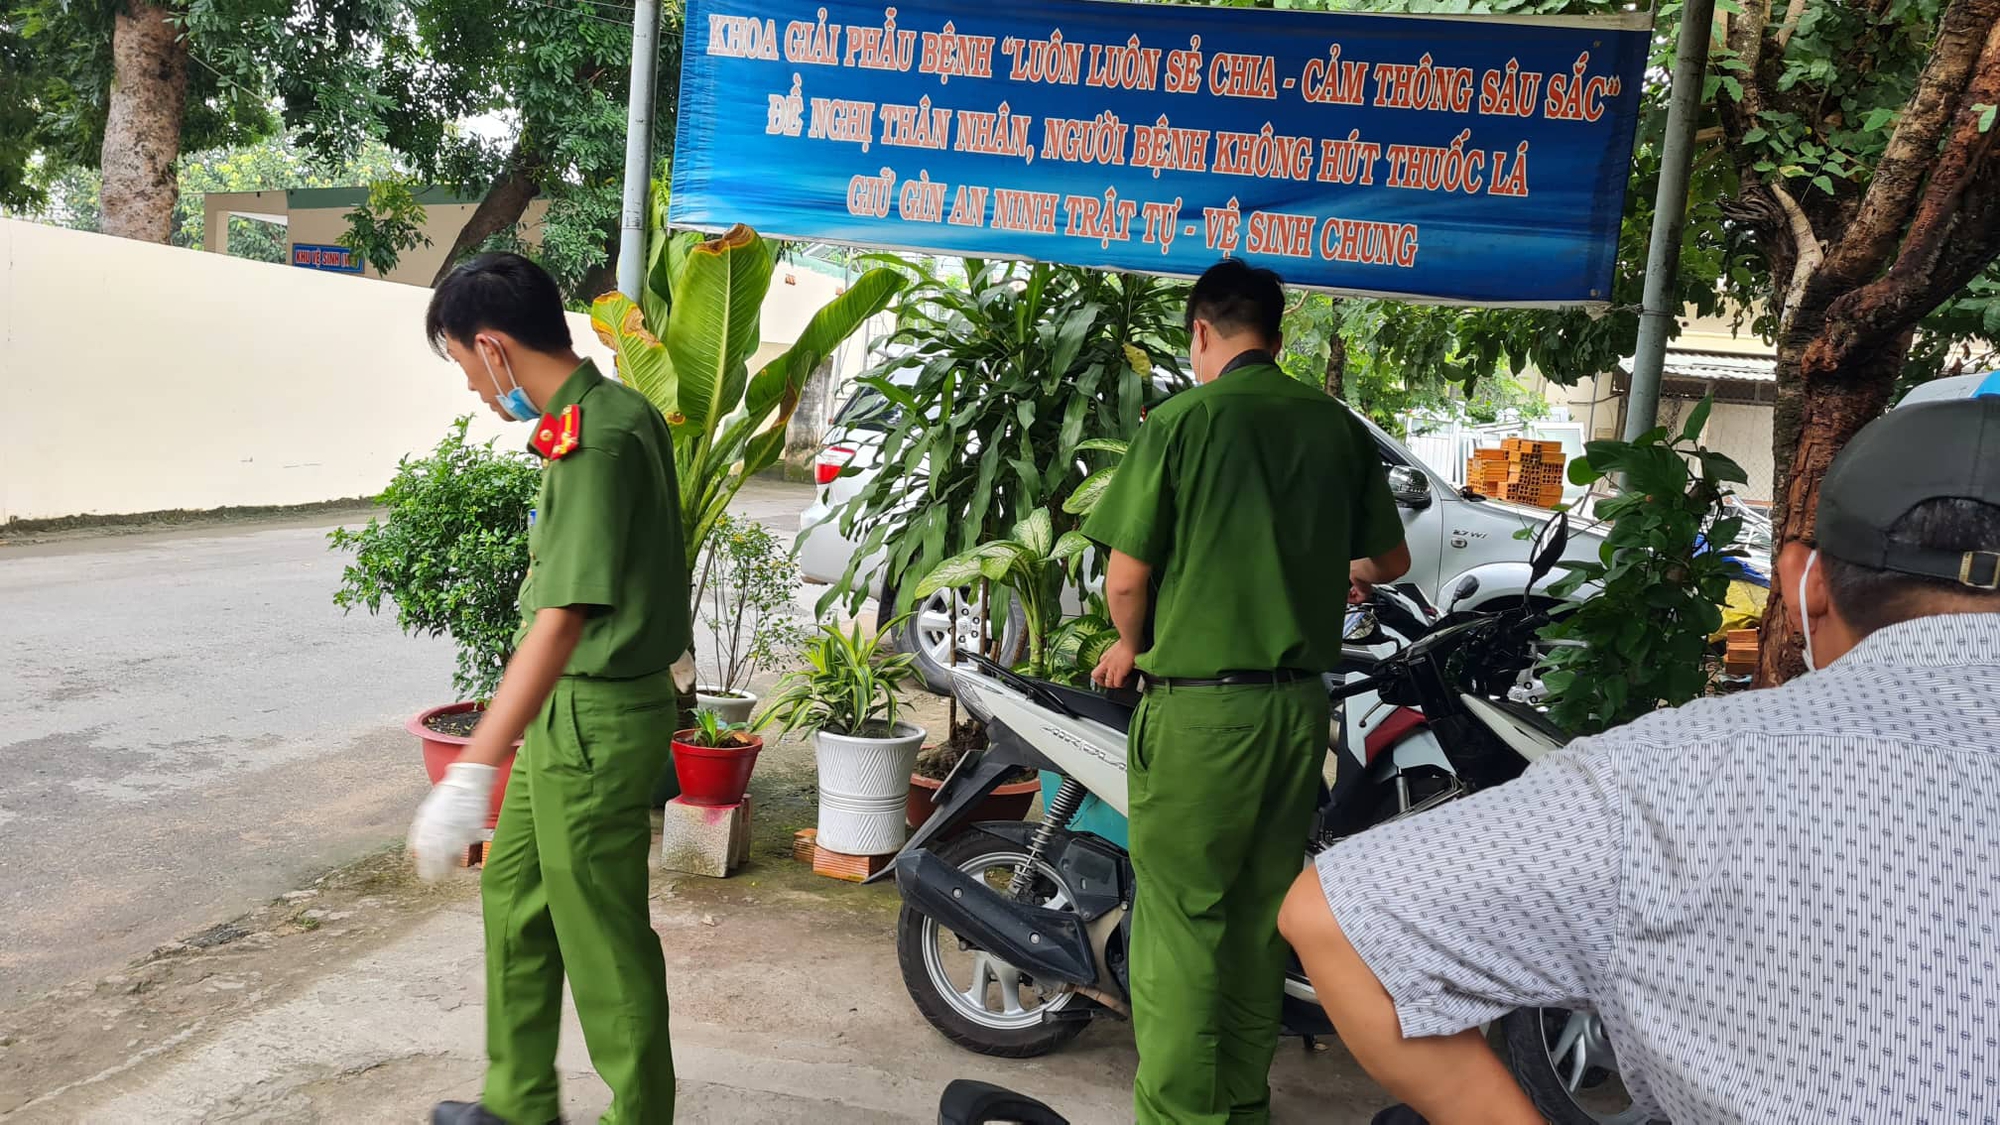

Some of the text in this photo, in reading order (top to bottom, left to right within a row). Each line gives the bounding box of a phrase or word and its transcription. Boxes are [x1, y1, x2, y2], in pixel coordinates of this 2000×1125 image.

[707, 14, 779, 60] KHOA
[784, 8, 841, 65] GIẢI
[919, 21, 995, 84] BỆNH
[1086, 34, 1161, 90] LUÔN
[1165, 35, 1202, 93] SẺ
[1209, 53, 1277, 99] CHIA
[1283, 78, 1295, 88] -
[1302, 44, 1368, 105] CẢM
[1373, 53, 1473, 112] THÔNG
[1479, 58, 1542, 117] SÂU
[766, 73, 1528, 197] ĐỀ NGHỊ THÂN NHÂN, NGƯỜI BỆNH KHÔNG HÚT THUỐC LÁ
[296, 249, 311, 264] KHU
[322, 251, 340, 266] SINH
[847, 167, 1418, 267] GIỮ GÌN AN NINH TRẬT TỰ - VỆ SINH CHUNG
